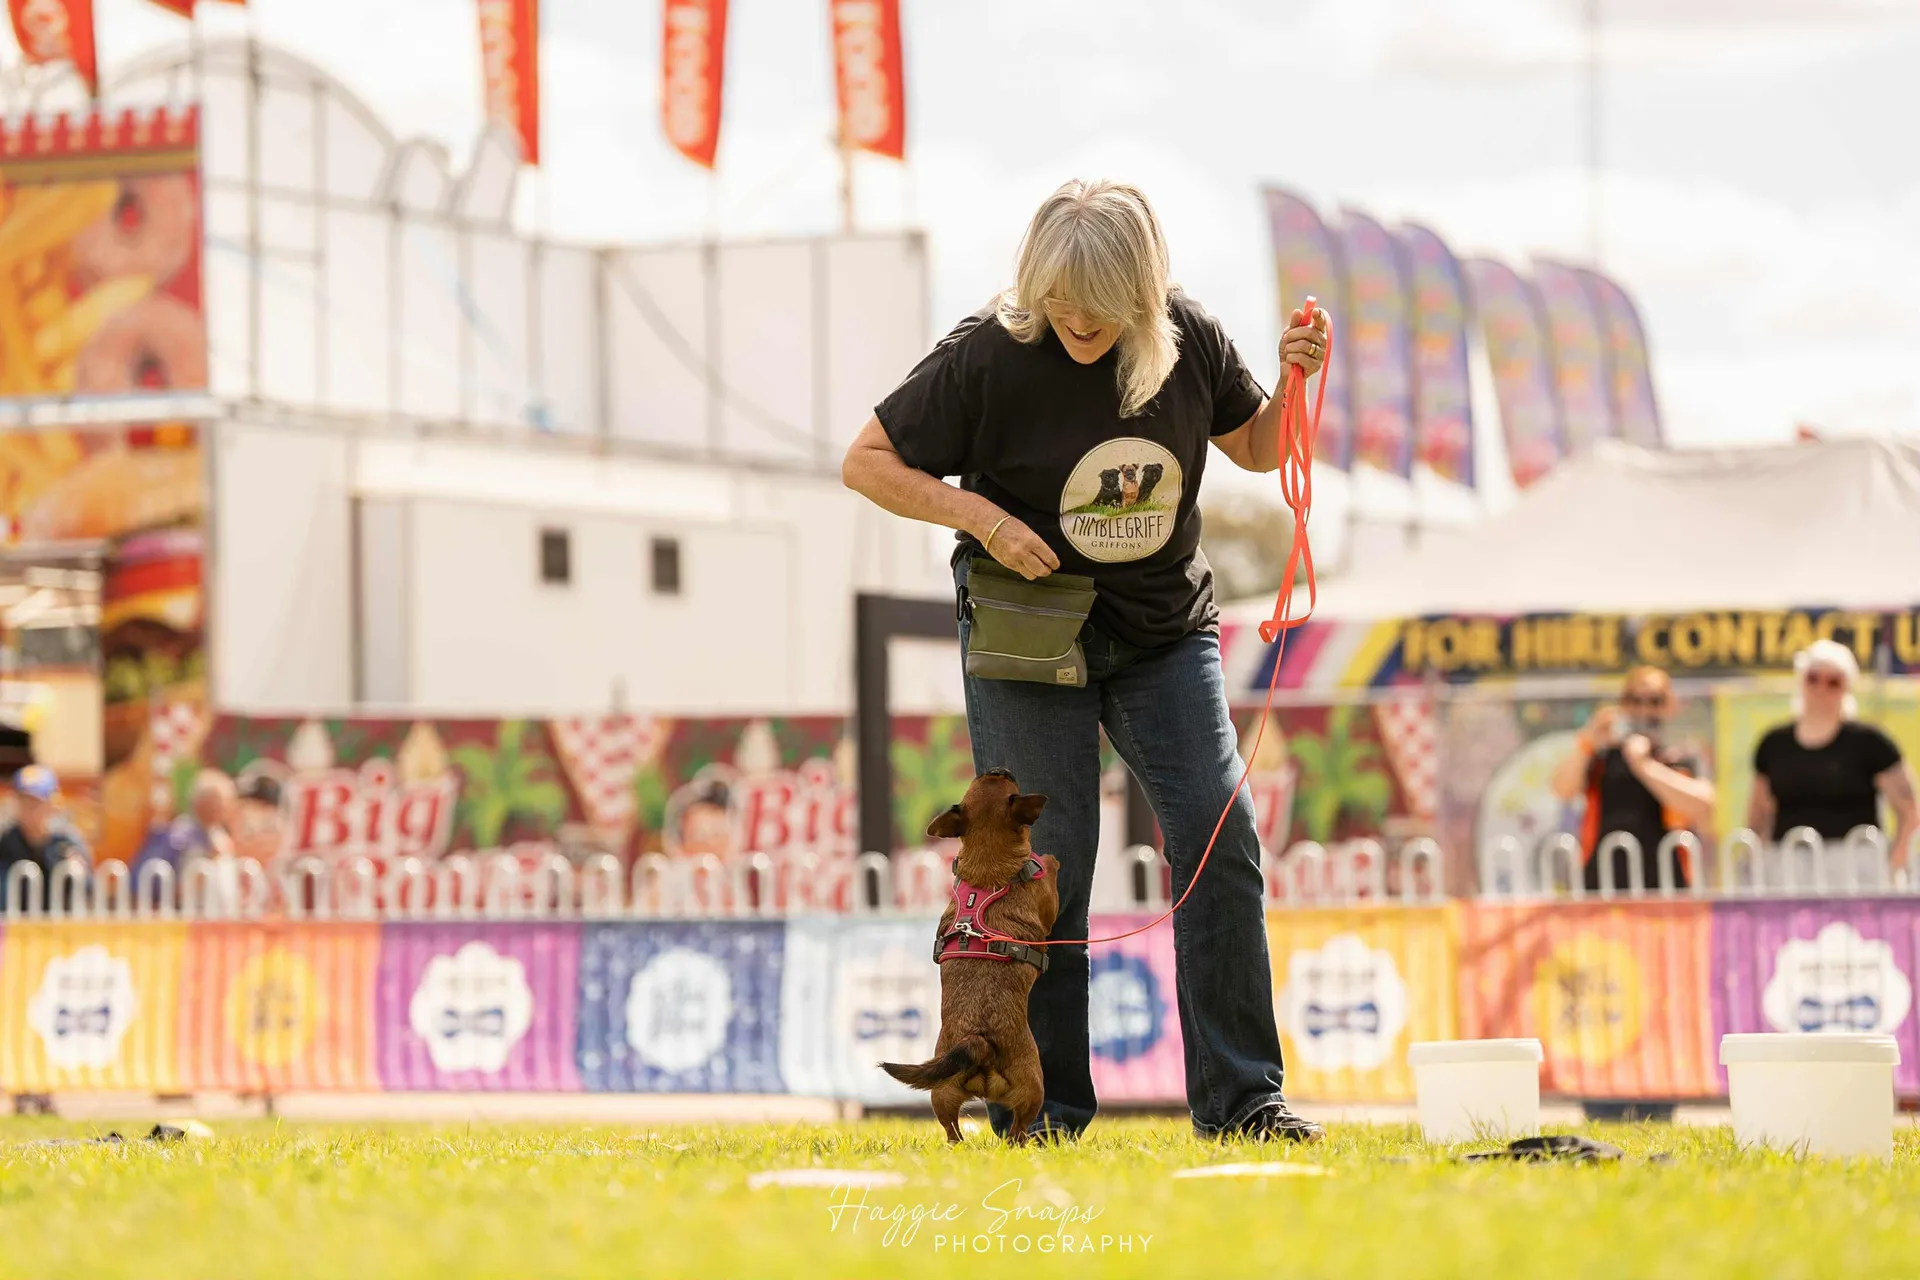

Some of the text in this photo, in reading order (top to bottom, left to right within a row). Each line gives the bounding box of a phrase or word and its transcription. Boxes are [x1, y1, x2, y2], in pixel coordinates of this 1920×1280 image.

[1072, 515, 1165, 539] NIMBLEGRIFF
[1091, 541, 1142, 550] GRIFFONS
[1403, 616, 1499, 671] FOR
[1637, 610, 1882, 668] CONTACT
[297, 772, 448, 857] Big
